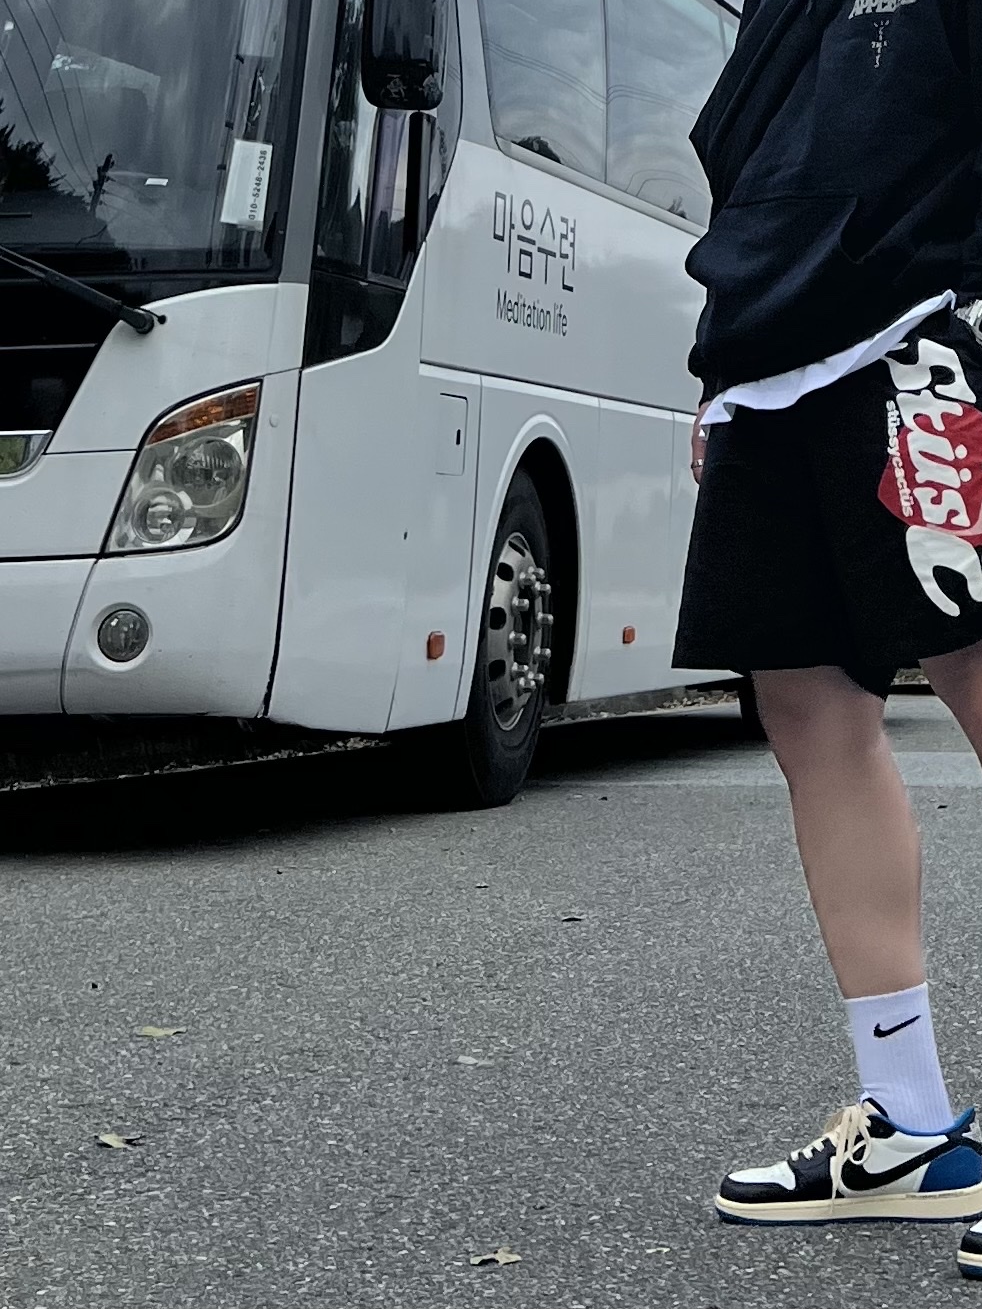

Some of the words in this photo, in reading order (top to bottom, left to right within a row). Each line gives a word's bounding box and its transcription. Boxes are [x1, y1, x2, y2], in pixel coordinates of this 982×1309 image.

[493, 191, 577, 293] 마음수련
[496, 288, 551, 333] Meditation
[552, 302, 568, 337] life
